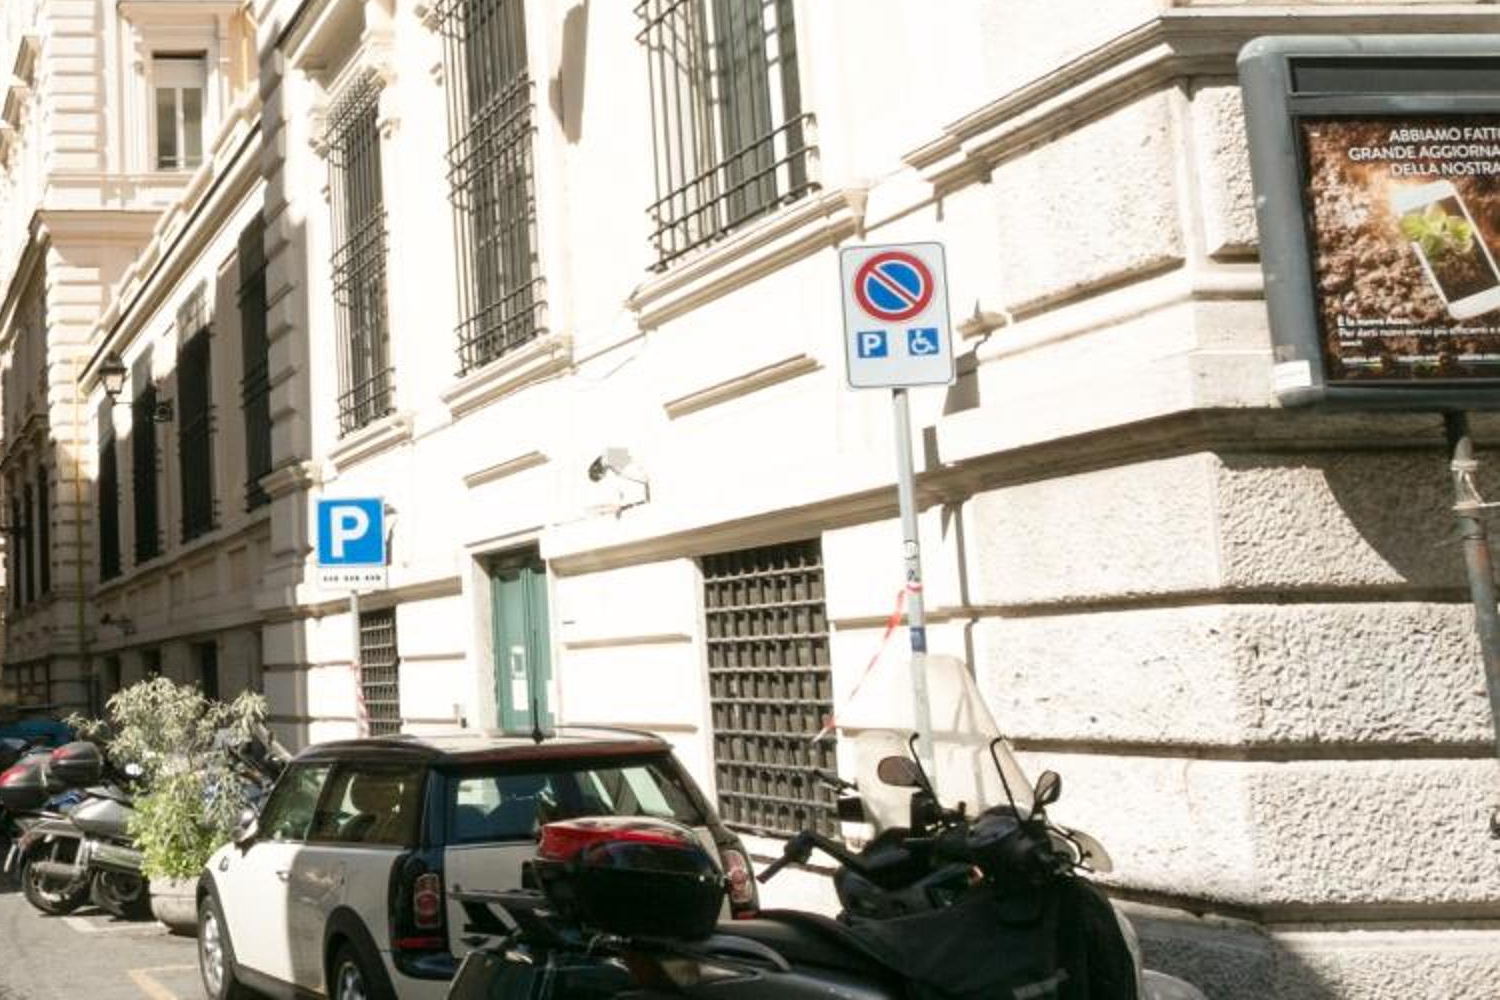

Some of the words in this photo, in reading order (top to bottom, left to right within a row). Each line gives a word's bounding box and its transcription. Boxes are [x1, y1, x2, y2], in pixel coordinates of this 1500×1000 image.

[1389, 127, 1461, 142] ABBIAMO
[1463, 126, 1500, 140] FATT
[1348, 145, 1416, 160] GRANDE
[1391, 162, 1439, 176] DELLA
[863, 333, 882, 356] P
[330, 505, 370, 559] P
